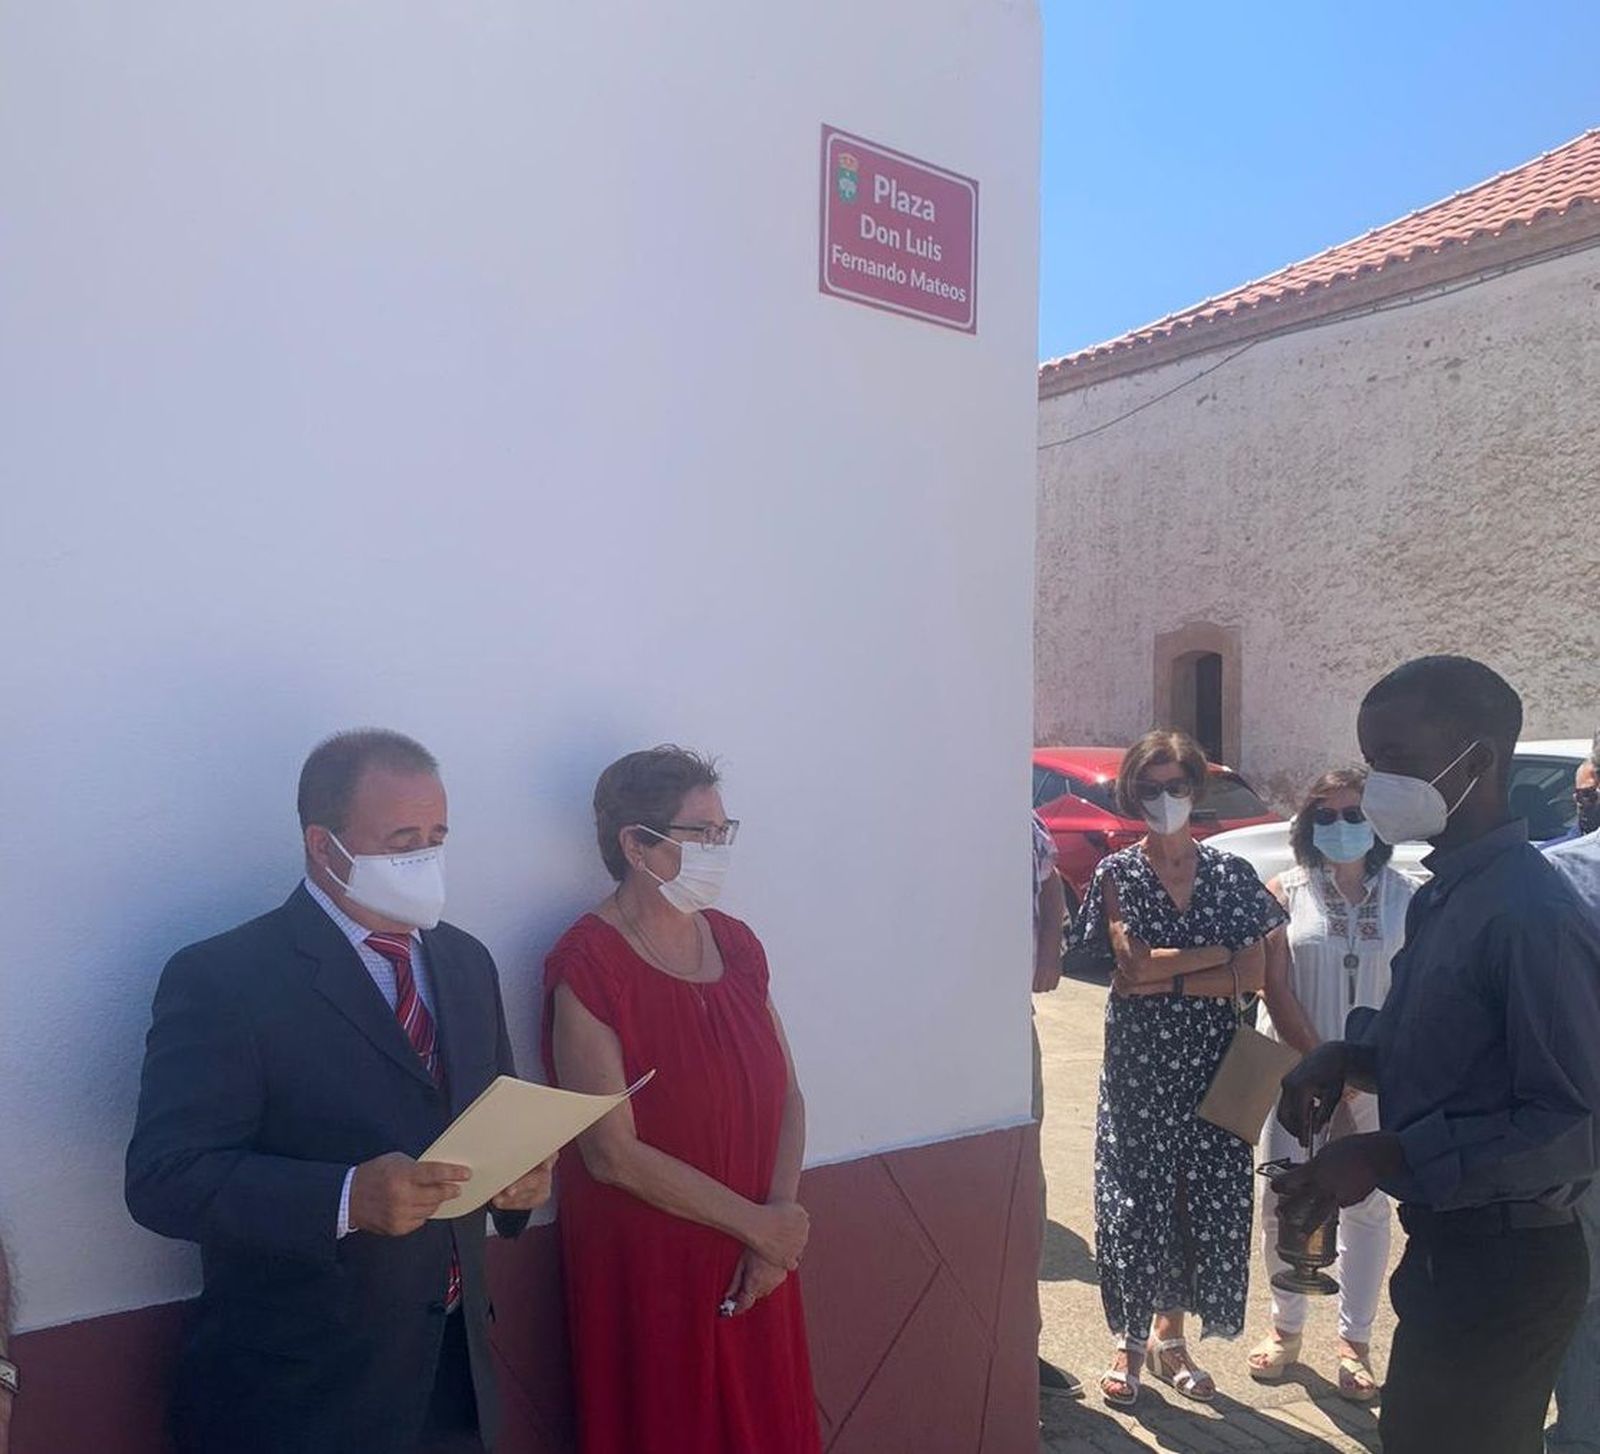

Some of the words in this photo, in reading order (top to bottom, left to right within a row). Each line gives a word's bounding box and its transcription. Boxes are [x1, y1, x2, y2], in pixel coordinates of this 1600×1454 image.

[874, 174, 935, 222] Plaza
[860, 214, 900, 249] Don
[906, 229, 942, 262] Luis
[831, 244, 907, 284] Fernando
[910, 268, 967, 303] Mateos
